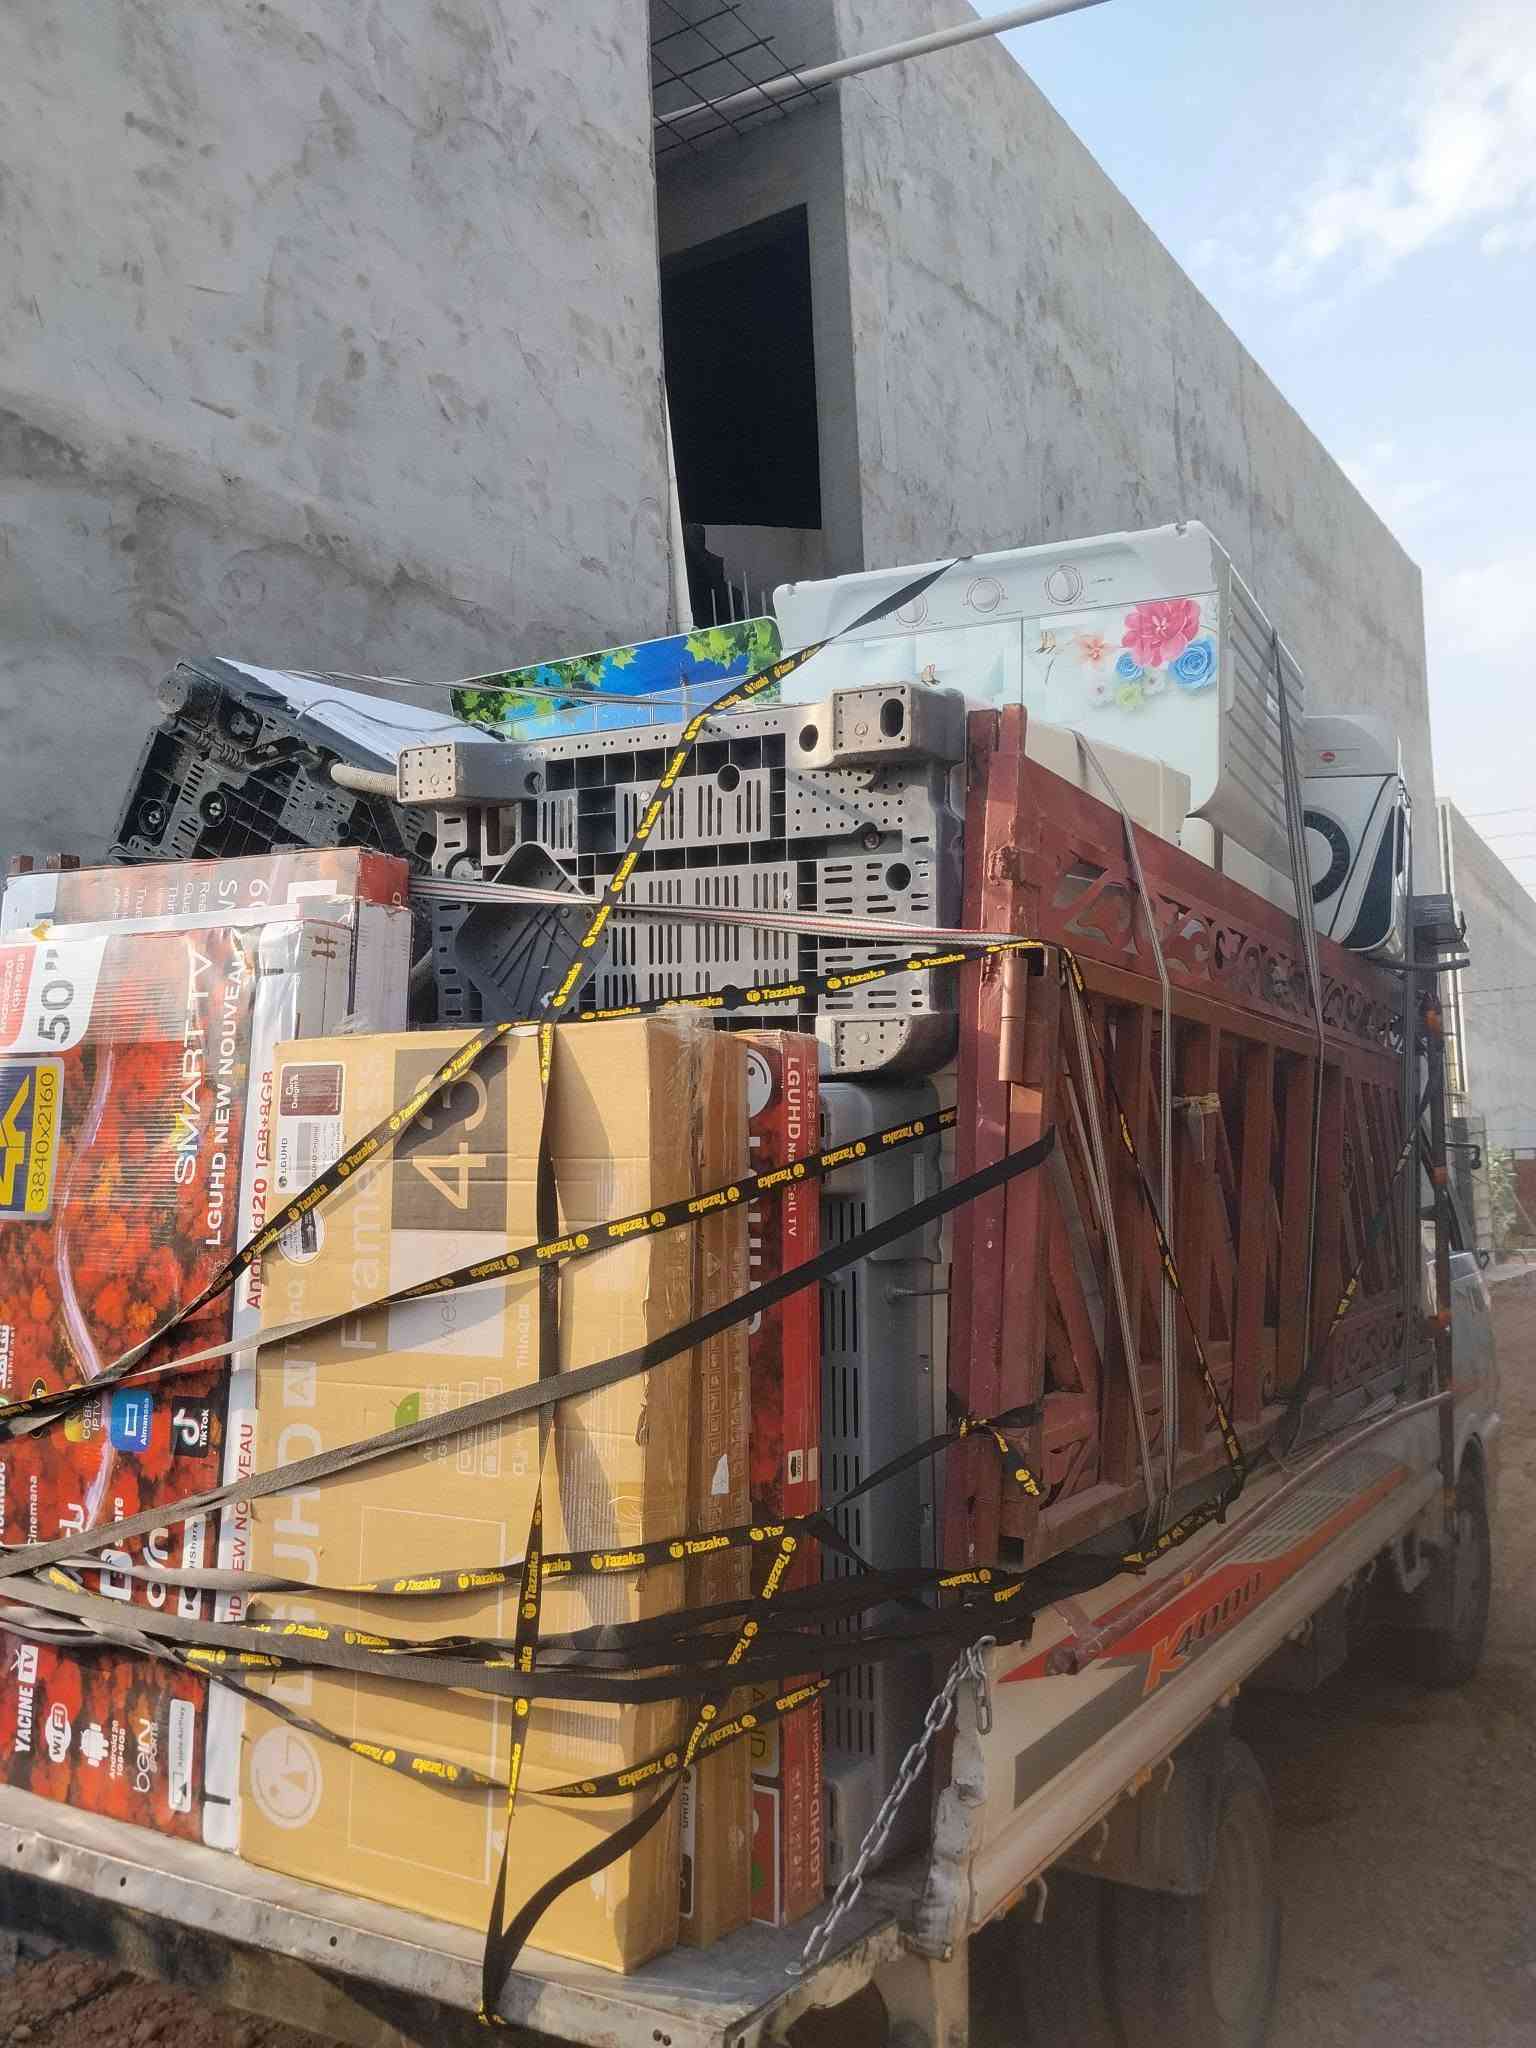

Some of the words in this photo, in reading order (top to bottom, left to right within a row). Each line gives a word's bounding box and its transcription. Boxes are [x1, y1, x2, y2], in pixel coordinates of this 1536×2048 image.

[671, 752, 686, 780] Tazaka
[646, 800, 663, 830] Tazaka
[620, 851, 639, 882] Tazaka
[591, 905, 611, 937] Tazaka
[922, 952, 966, 968] Tazaka
[186, 940, 213, 1010] TV
[562, 961, 583, 998] Tazaka
[842, 968, 885, 987] Tazaka
[760, 982, 806, 1000] Tazaka
[596, 1006, 641, 1020] Tazaka
[451, 1040, 482, 1072] Tazaka
[542, 1023, 553, 1067] Tazaka
[174, 1012, 206, 1185] SMART
[399, 1091, 429, 1122] Tazaka
[786, 1056, 801, 1140] LGUHD
[214, 1084, 231, 1144] NEW
[30, 1072, 55, 1204] 3840x2160
[412, 1069, 490, 1210] 43
[882, 1124, 917, 1146] Tazaka
[349, 1138, 379, 1167] Tazaka
[821, 1146, 858, 1167] Tazaka
[758, 1168, 794, 1190] Tazaka
[206, 1152, 225, 1246] LGUHD
[298, 1184, 329, 1212] Tazaka
[689, 1193, 729, 1213] Tazaka
[608, 1215, 651, 1237] Tazaka
[787, 1216, 798, 1238] TV
[536, 1240, 577, 1259] Tazaka
[470, 1261, 508, 1278] Tazaka
[199, 1408, 210, 1448] TikTok
[234, 1424, 253, 1531] NOVEAU
[685, 1535, 730, 1554] Tazaka
[604, 1551, 646, 1568] Tazaka
[471, 1572, 505, 1587] Tazaka
[525, 1551, 538, 1600] Tazaka
[762, 1552, 791, 1600] Tazaka
[776, 1687, 819, 1711] Tazaka
[15, 1685, 34, 1752] YACINE
[412, 1758, 447, 1778] Tazaka
[618, 1763, 664, 1787] Tazaka
[808, 1798, 823, 1888] LGUHD
